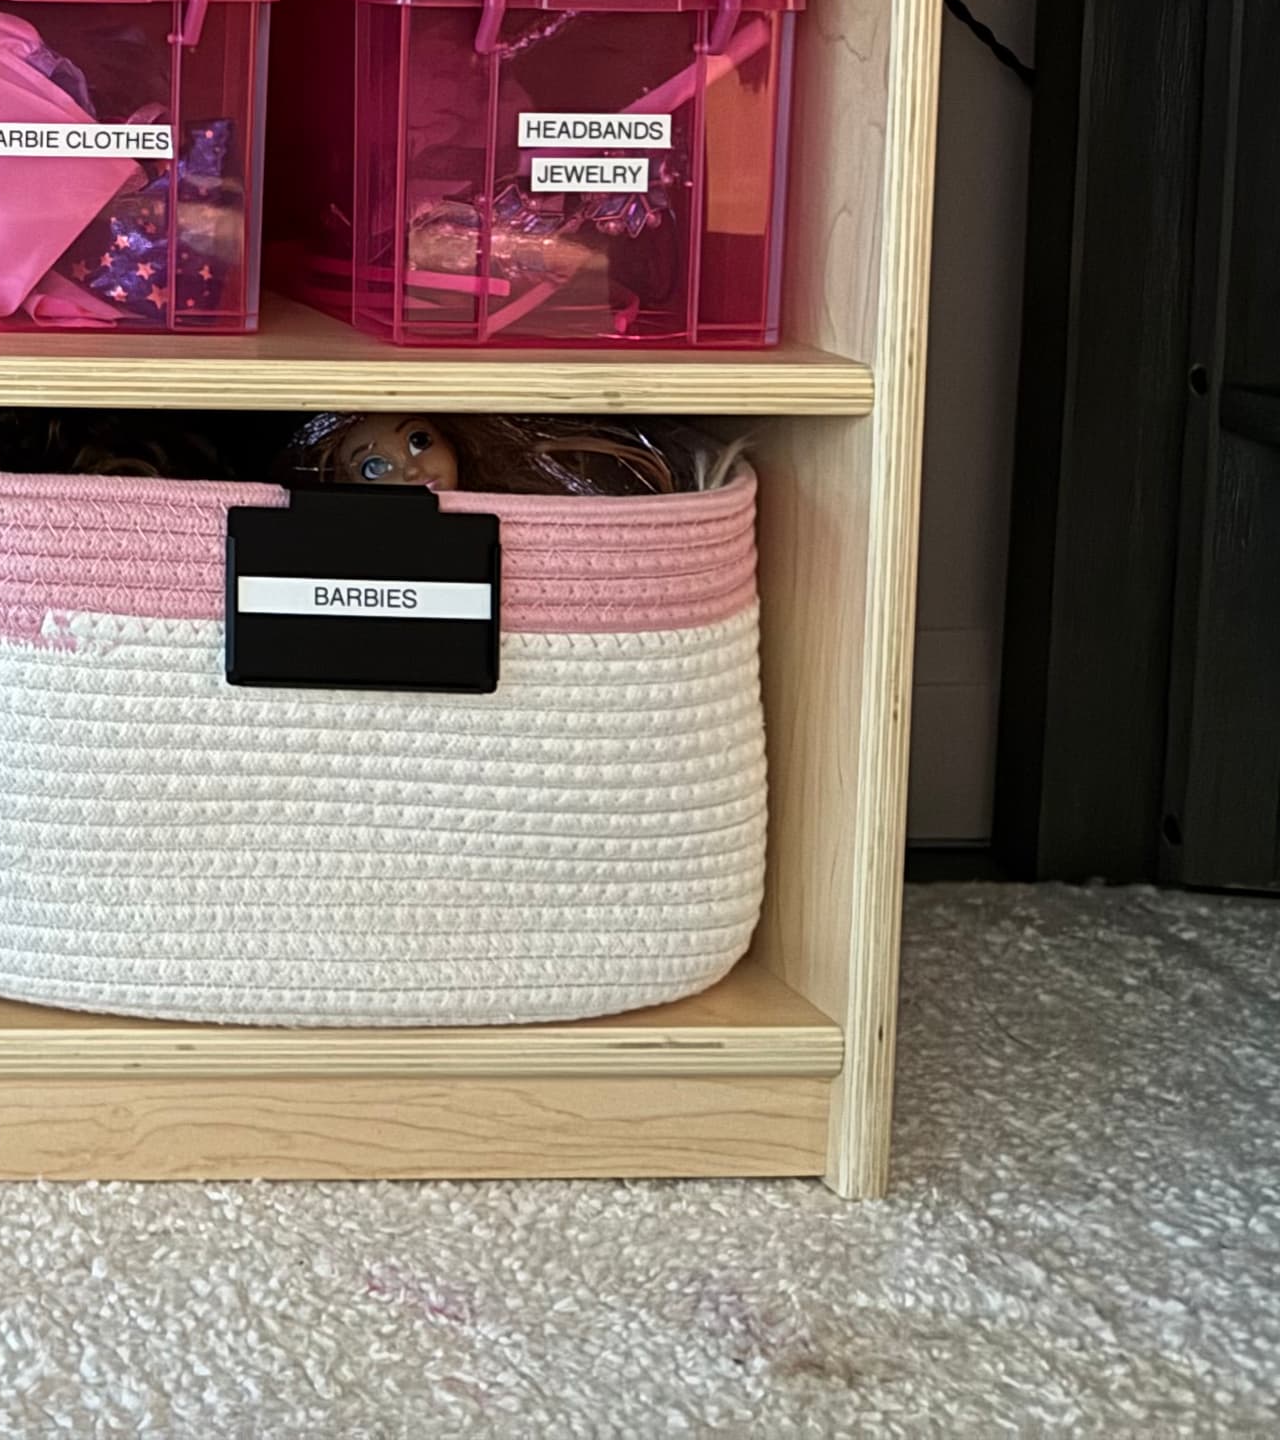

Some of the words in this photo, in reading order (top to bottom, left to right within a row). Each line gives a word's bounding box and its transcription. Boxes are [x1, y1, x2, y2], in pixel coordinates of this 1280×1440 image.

[526, 120, 664, 140] HEADBANDS
[66, 131, 169, 150] CLOTHES
[537, 165, 642, 183] JEWELRY
[314, 586, 418, 609] BARBIES
